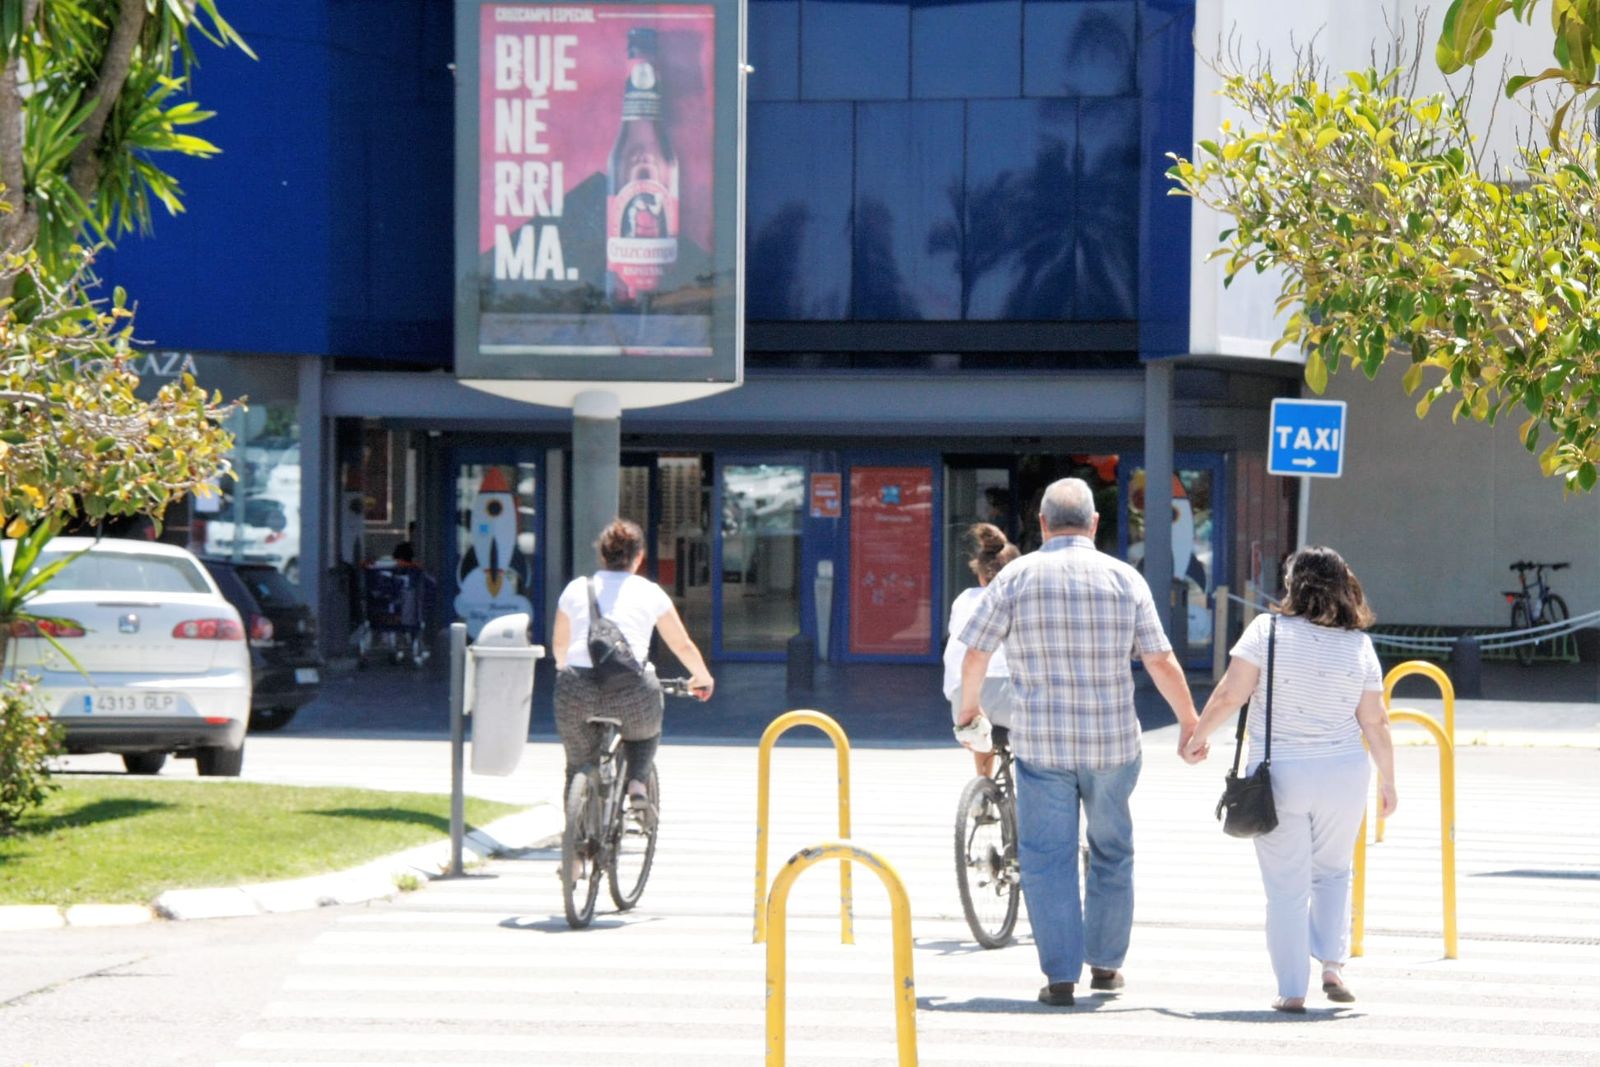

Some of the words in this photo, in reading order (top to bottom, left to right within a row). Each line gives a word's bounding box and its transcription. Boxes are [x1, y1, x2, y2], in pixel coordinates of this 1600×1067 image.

[495, 34, 578, 97] BUE
[495, 161, 564, 217] RRI
[494, 224, 579, 280] MA.
[1276, 426, 1339, 451] TAXI
[96, 695, 136, 711] 4313
[143, 695, 173, 711] GLP
